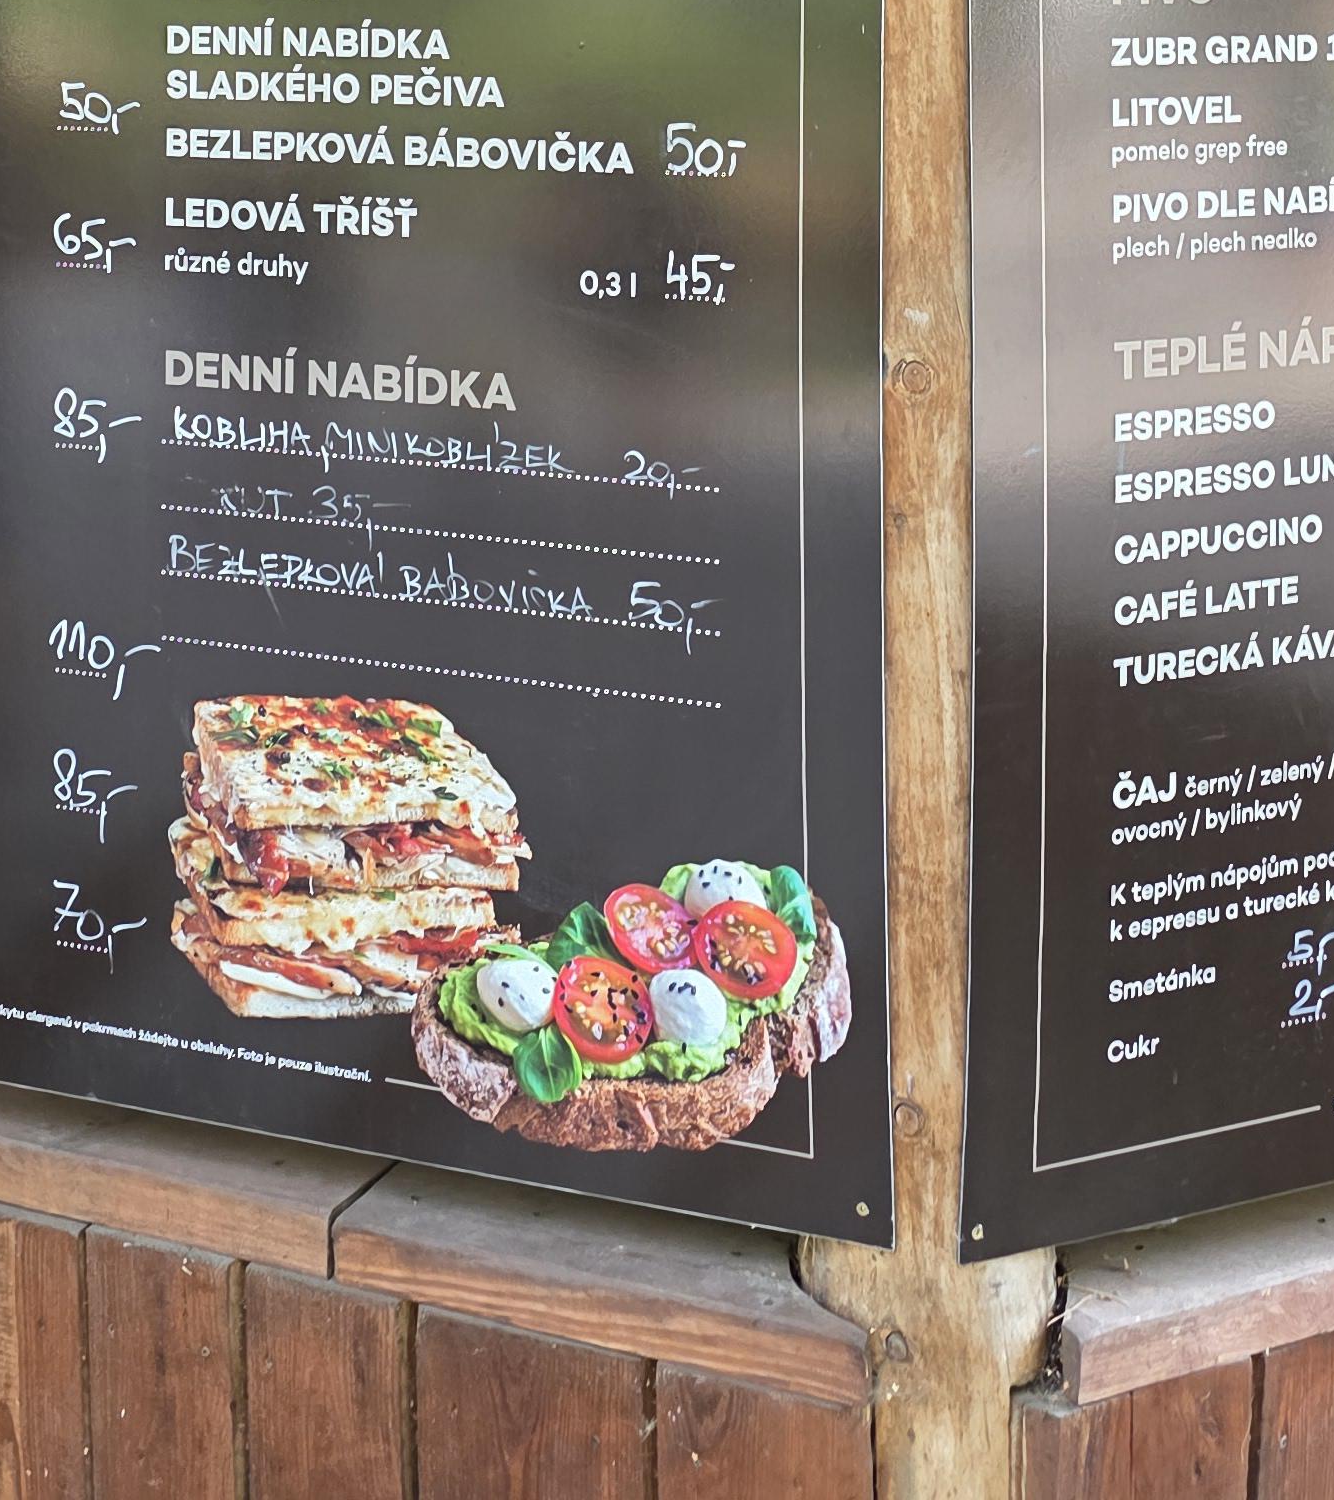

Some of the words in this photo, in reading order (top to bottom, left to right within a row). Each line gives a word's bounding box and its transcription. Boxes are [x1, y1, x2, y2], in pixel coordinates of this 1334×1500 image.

[1111, 37, 1197, 66] ZUBR
[1205, 35, 1317, 64] GRAND
[167, 126, 394, 164] BEZLEPKOVÁ
[405, 128, 633, 174] BÁBOVIČKA
[313, 196, 417, 237] TŘÍŠŤ
[1114, 322, 1246, 380] TEPLÉ
[165, 347, 297, 394] DENNÍ
[309, 356, 516, 410] NABÍDKA
[1115, 460, 1275, 503] ESPRESSO
[1112, 812, 1187, 844] ovocný
[1206, 793, 1301, 833] bylinkový
[1109, 964, 1215, 1002] Smetánka
[238, 1048, 263, 1062] Foto
[278, 1058, 312, 1071] pouze
[1108, 1034, 1159, 1062] Cukr
